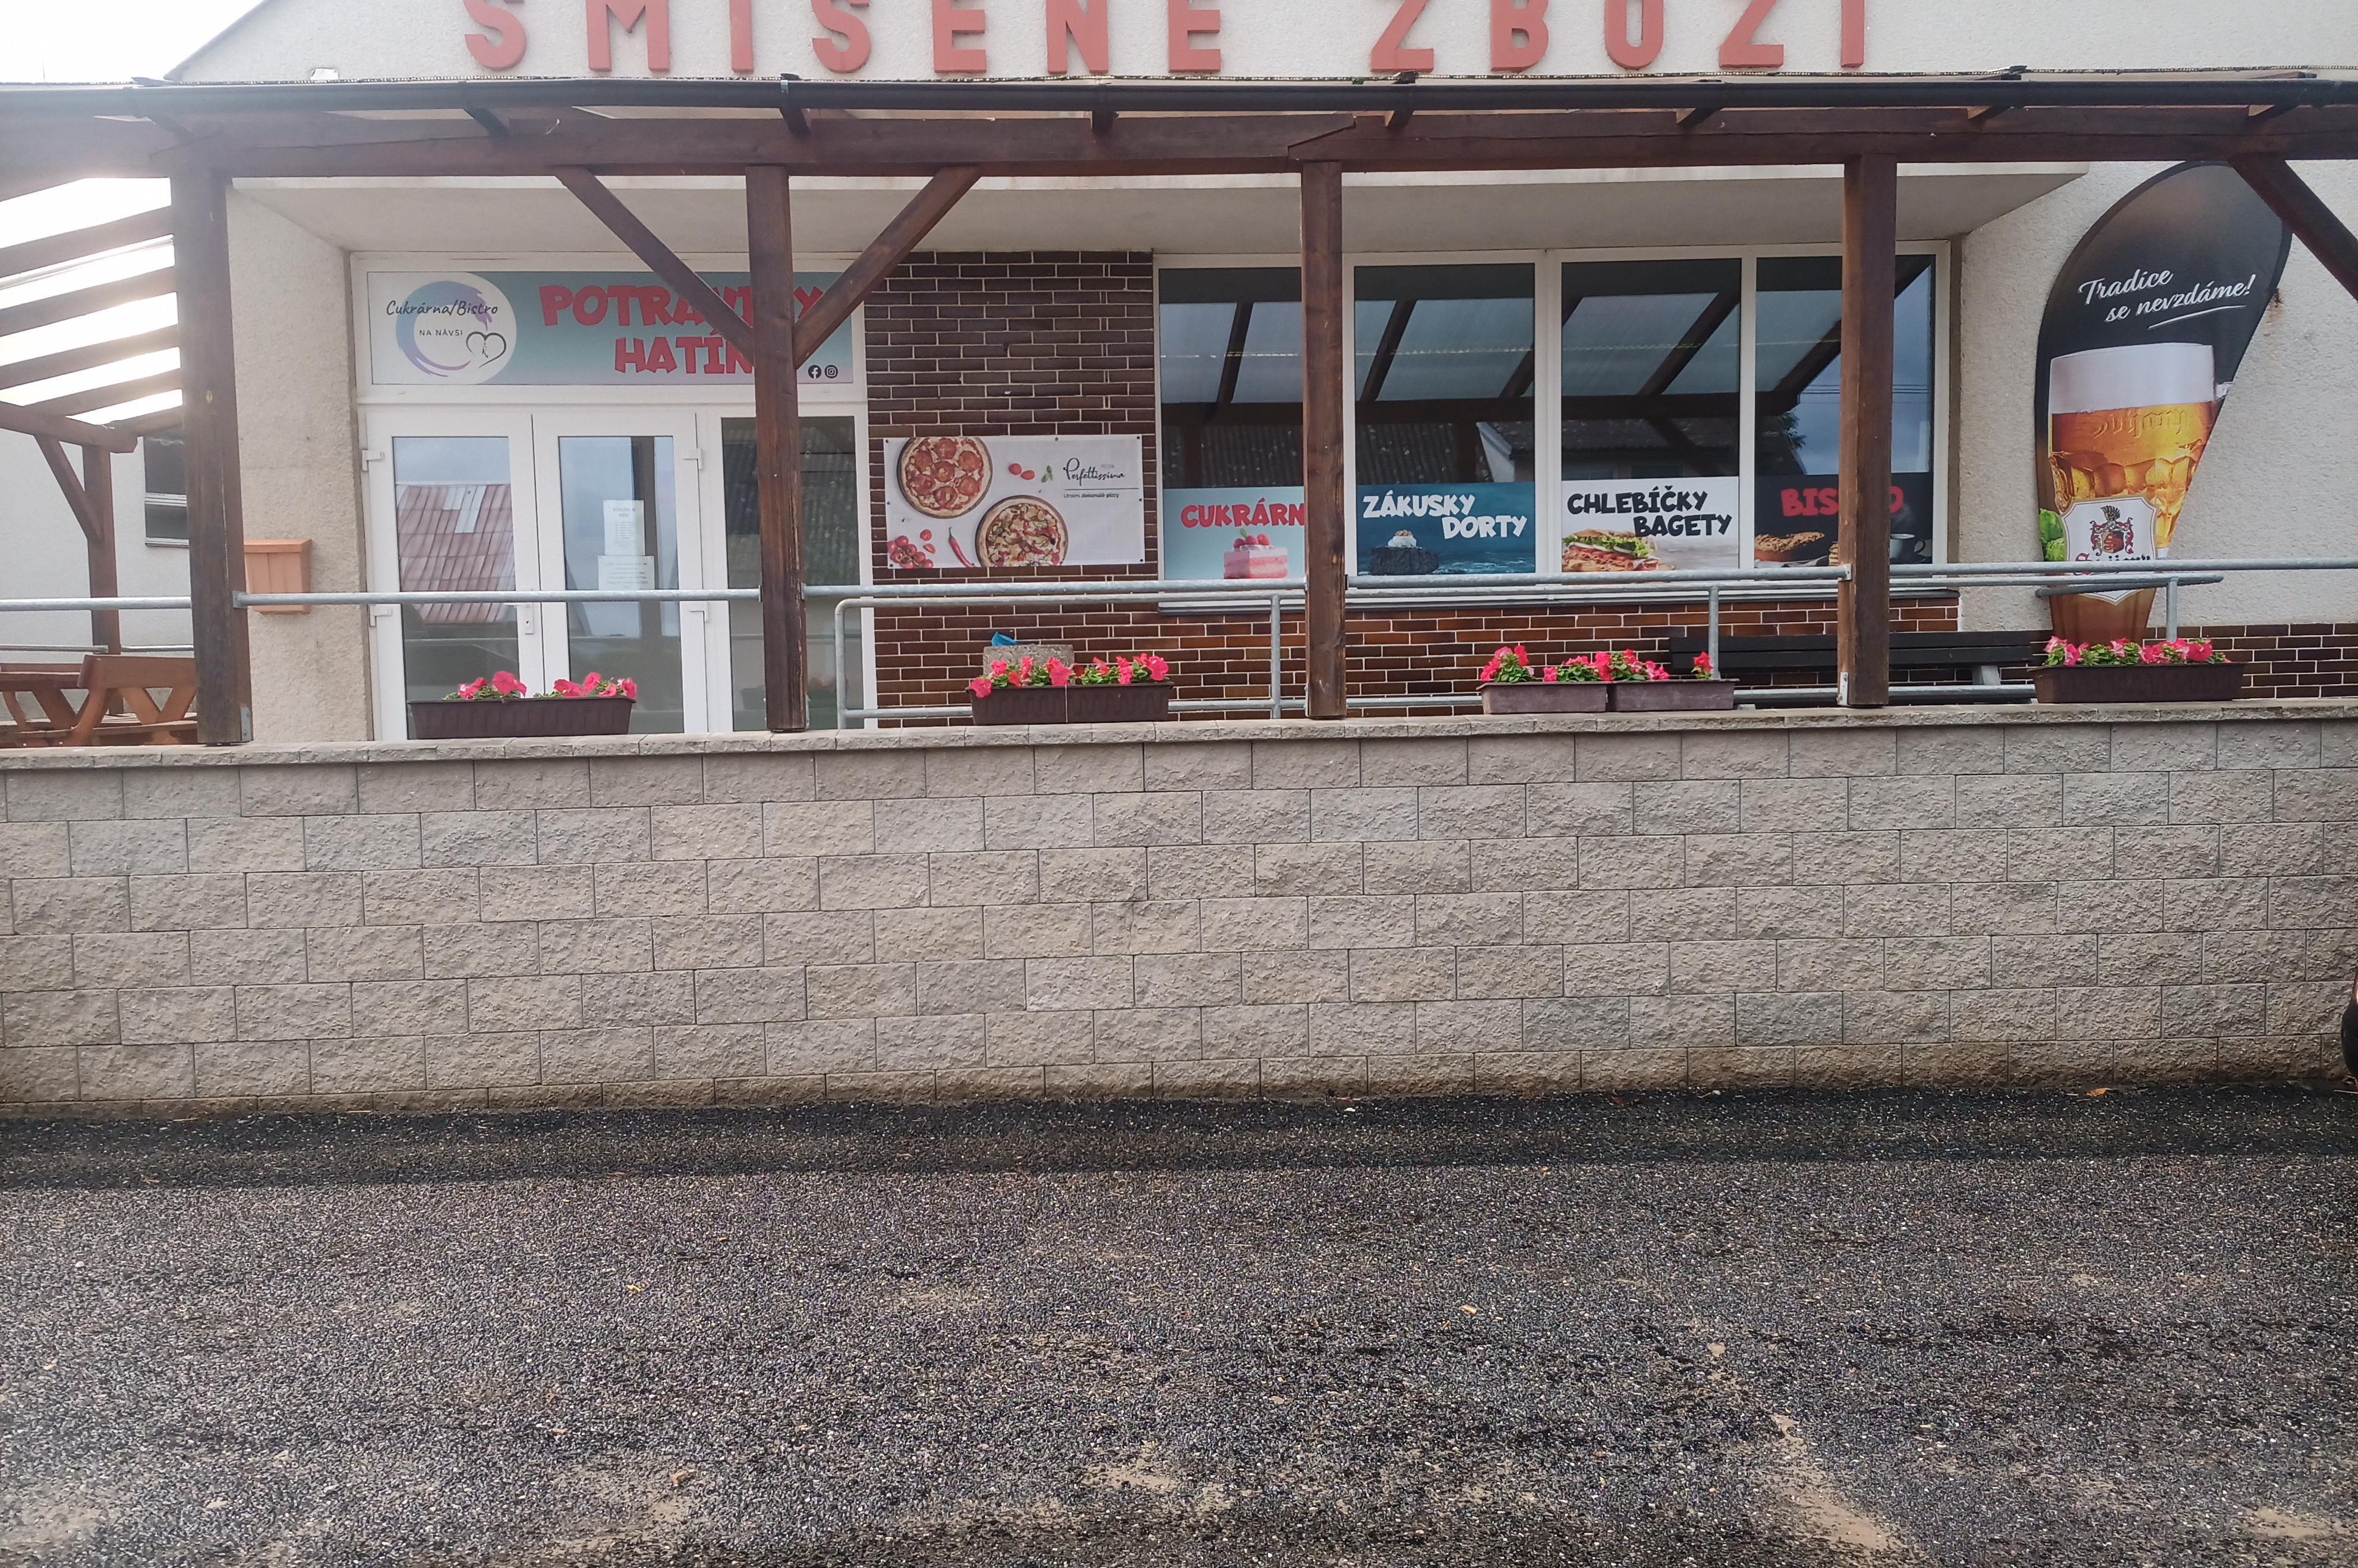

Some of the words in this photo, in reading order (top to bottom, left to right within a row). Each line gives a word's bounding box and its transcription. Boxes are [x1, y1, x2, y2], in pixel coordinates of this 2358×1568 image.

[2078, 268, 2174, 305] Tradice
[2104, 303, 2130, 323] se
[2136, 273, 2257, 316] nevzdáme!
[386, 299, 499, 316] Cukrárna/Bistro
[1063, 457, 1126, 486] Perfettissima
[1363, 490, 1476, 518] ZÁKUSKY
[1566, 485, 1708, 515] CHLEBÍČKY
[1780, 486, 1905, 517] BISO
[1441, 515, 1528, 540] DORTY
[1633, 513, 1733, 537] BAGETY
